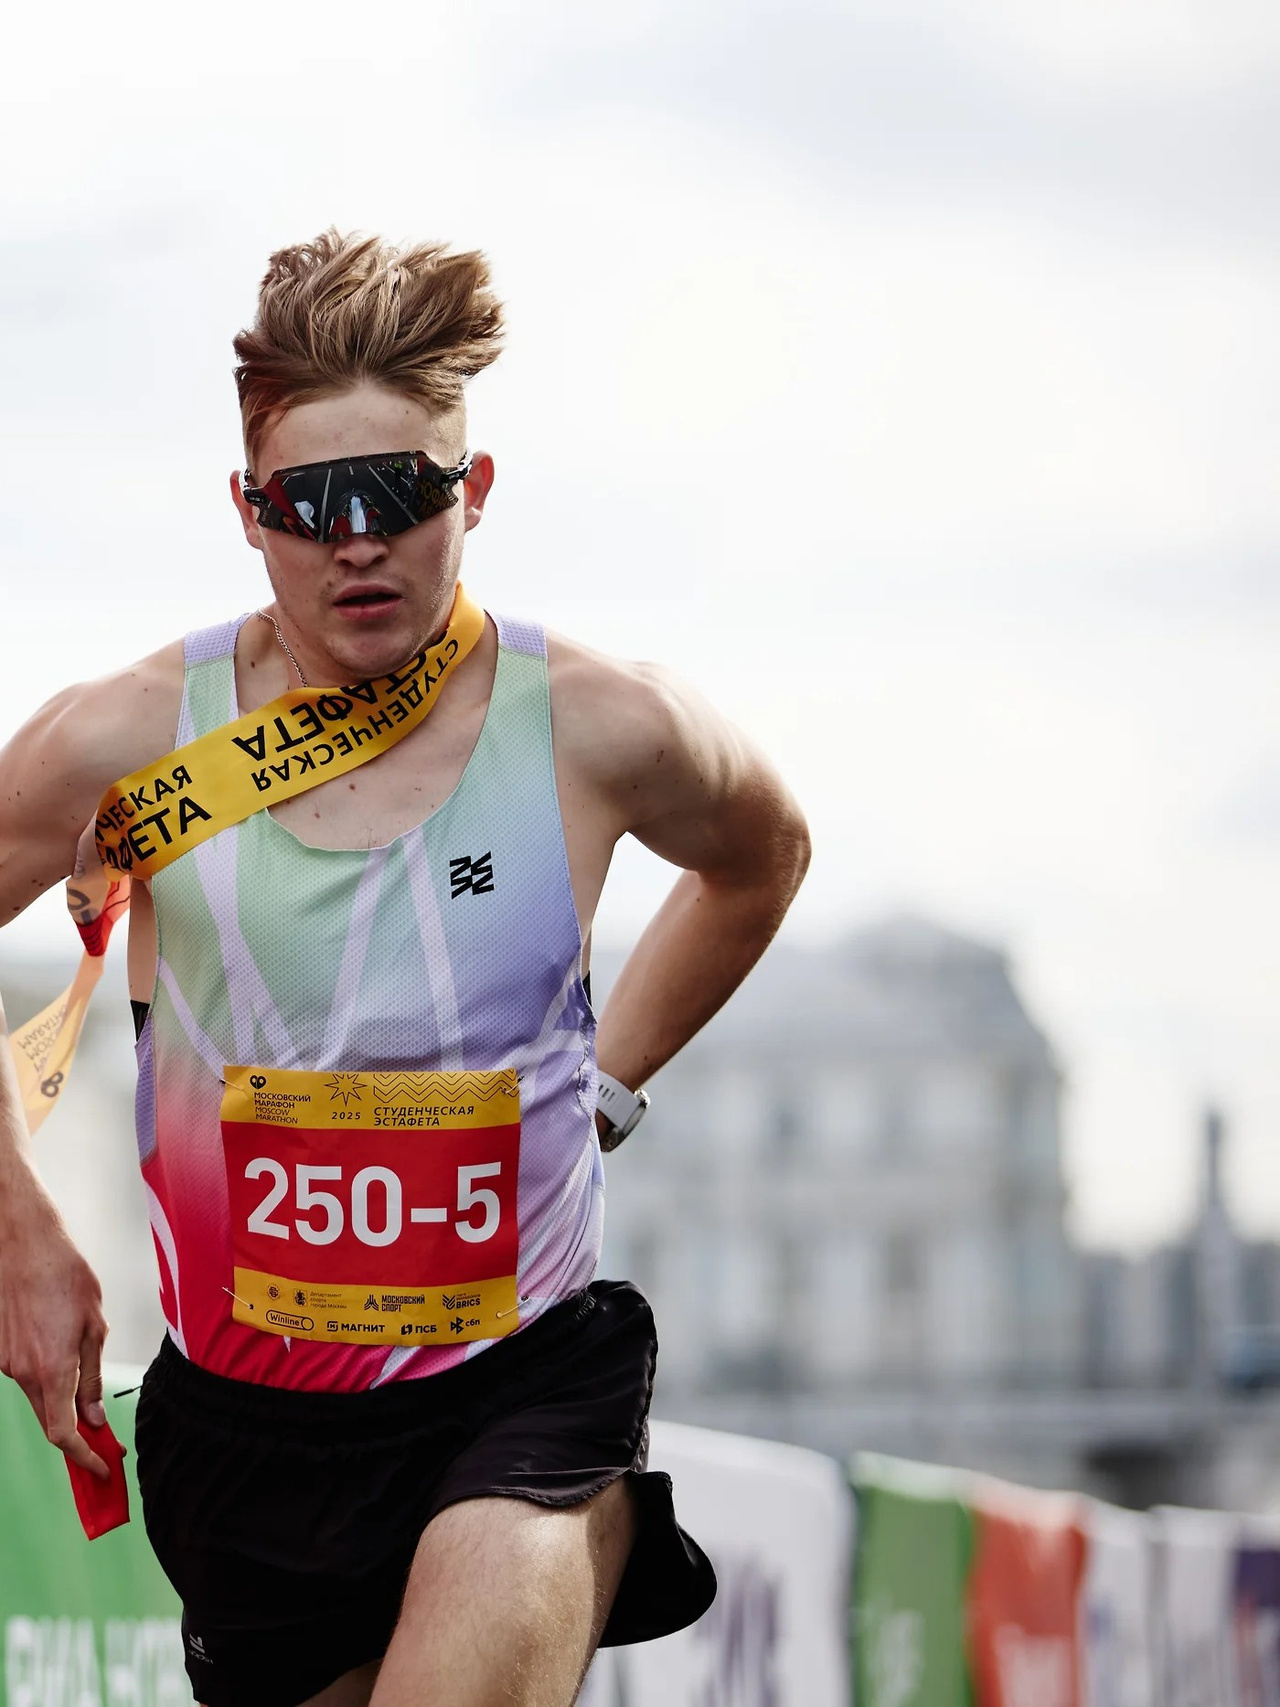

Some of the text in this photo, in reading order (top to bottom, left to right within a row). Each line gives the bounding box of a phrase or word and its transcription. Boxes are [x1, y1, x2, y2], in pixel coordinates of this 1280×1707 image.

[251, 638, 459, 792] СТУДЕНЧЕСКАЯ
[254, 1092, 311, 1102] МОСКОВСКИЙ
[254, 1100, 295, 1109] МАРАФОН
[255, 1107, 290, 1115] MOSCOW
[331, 1111, 361, 1120] 2025
[373, 1106, 475, 1118] СТУДЕНЧЕСКАЯ
[255, 1114, 298, 1124] MARATHON
[373, 1117, 440, 1127] ЭСТАФЕТА
[244, 1157, 502, 1247] 250-5
[381, 1294, 425, 1304] МОСКОВСКИЙ
[456, 1298, 481, 1309] BRICS
[381, 1304, 402, 1312] СПОРТ
[270, 1313, 300, 1327] Winline
[465, 1318, 480, 1327] сбп
[341, 1323, 385, 1333] МАГНИТ
[415, 1325, 437, 1334] ПСБ
